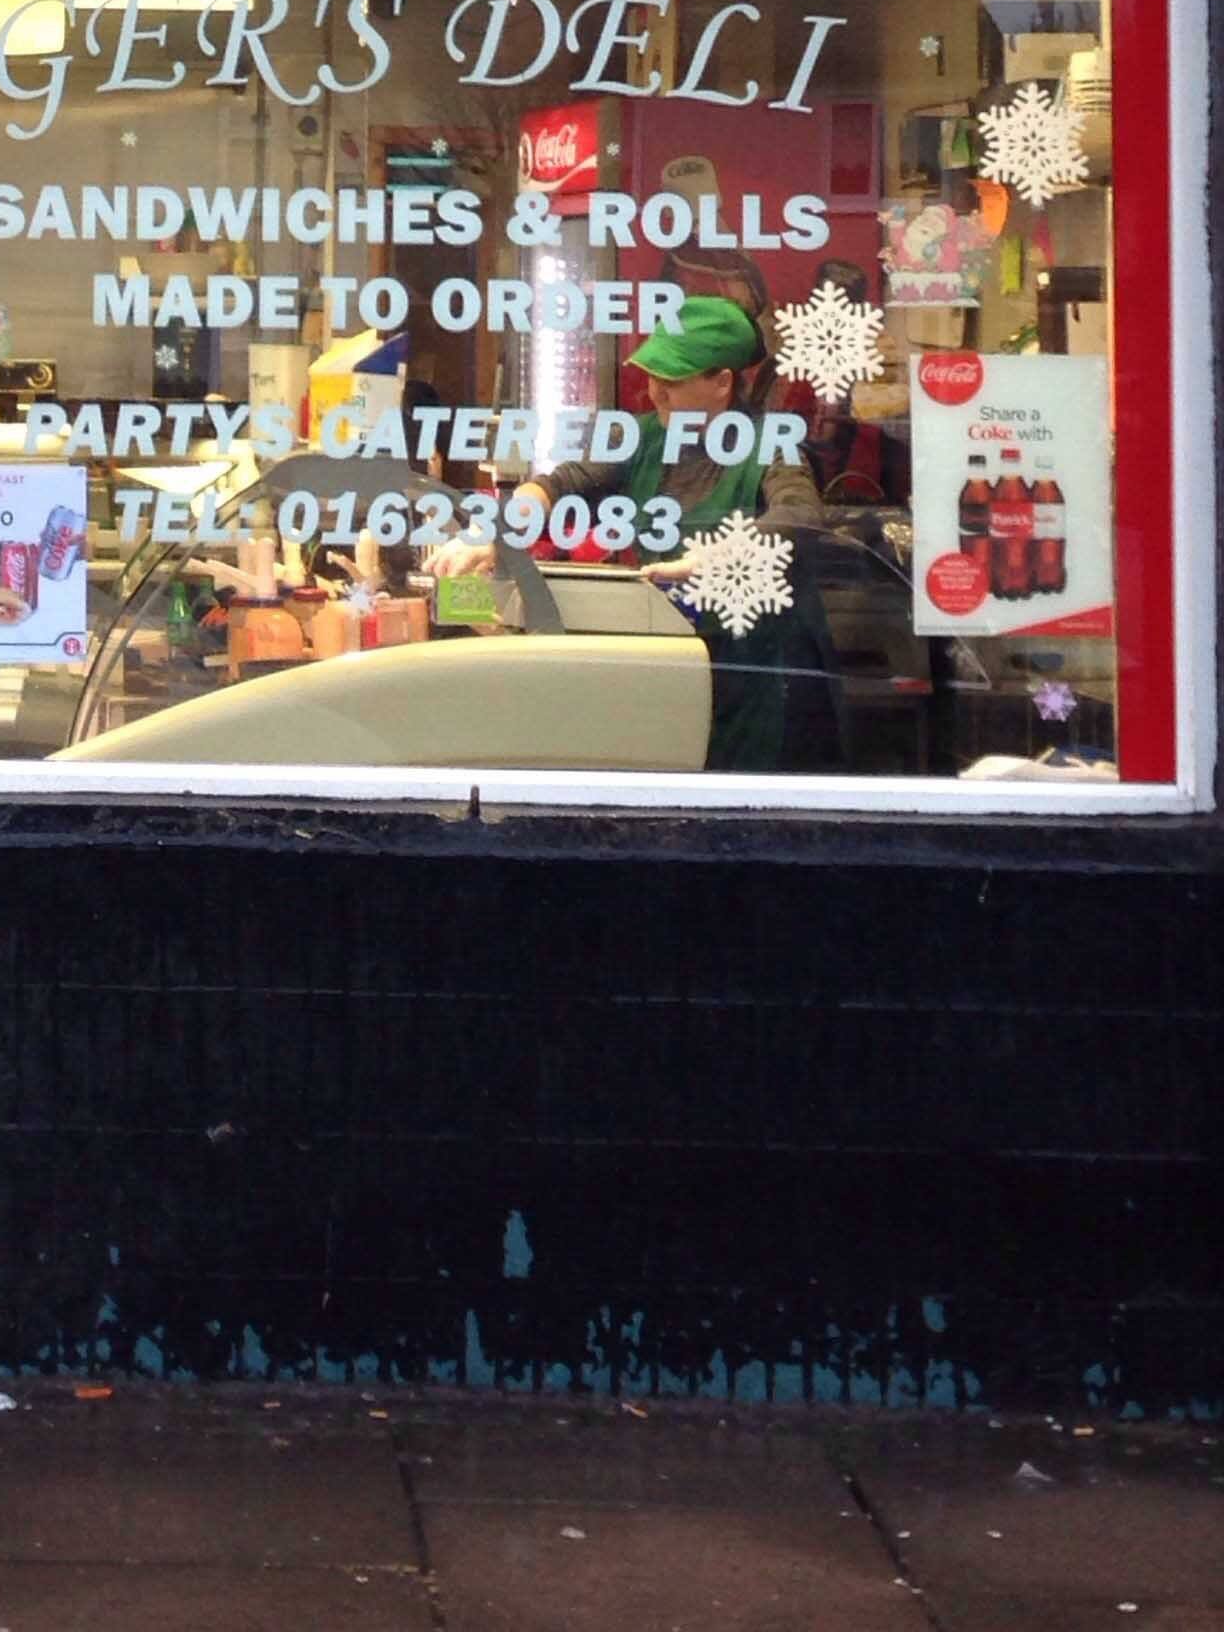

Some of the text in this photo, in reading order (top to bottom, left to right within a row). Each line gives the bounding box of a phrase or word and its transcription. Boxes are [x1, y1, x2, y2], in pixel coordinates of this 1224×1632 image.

[505, 190, 562, 246] &
[587, 193, 831, 250] ROLLS
[92, 275, 686, 335] MADE TO ORDER
[921, 363, 978, 384] Coca-Cola
[22, 401, 809, 465] PARTYS CATERED FOR
[968, 425, 1053, 441] Coke with
[980, 406, 1040, 421] Share a
[116, 488, 682, 553] TEL: 016239083
